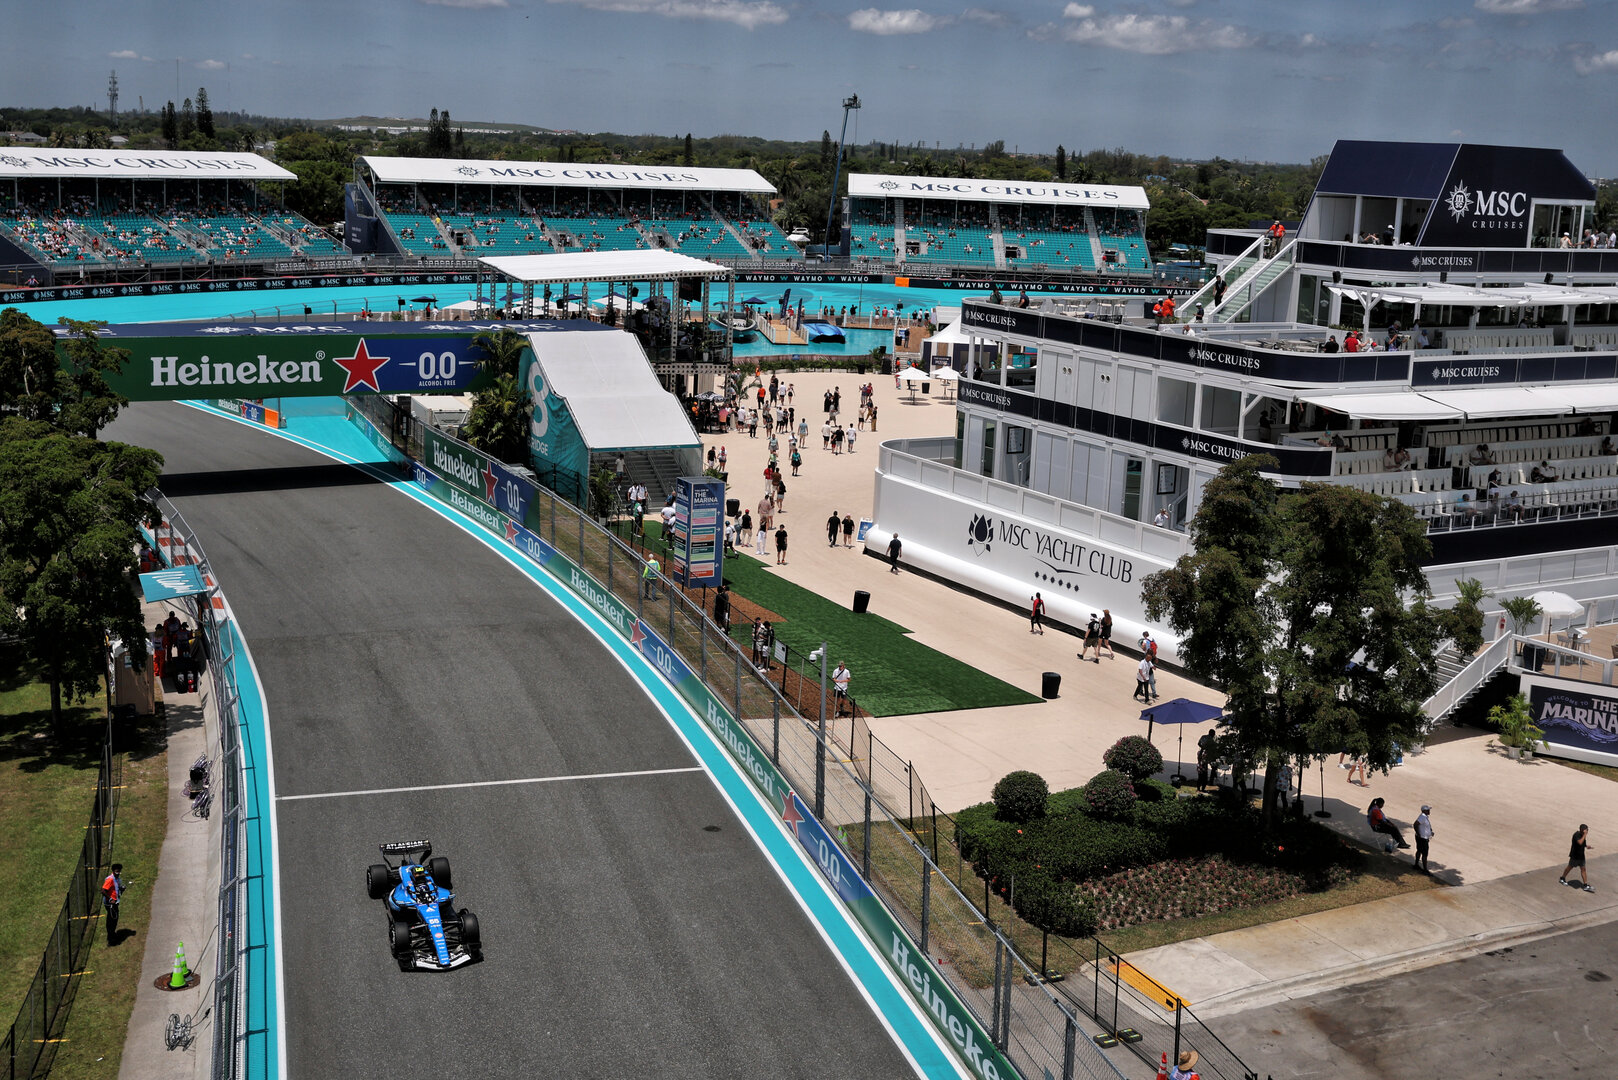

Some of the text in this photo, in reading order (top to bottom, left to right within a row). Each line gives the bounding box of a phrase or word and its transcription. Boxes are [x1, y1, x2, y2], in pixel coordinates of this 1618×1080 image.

[31, 156, 257, 170] MSC CRUISES
[487, 167, 699, 183] MSC CRUISES
[910, 182, 1119, 200] MSC CRUISES
[1474, 190, 1527, 217] MSC
[1472, 220, 1524, 229] CRUISES
[1421, 256, 1473, 266] MSC CRUISES
[958, 281, 990, 289] WAYMO
[1114, 286, 1146, 294] WAYMO
[969, 310, 1017, 327] MSC CRUISES
[418, 351, 456, 380] 0.0
[1196, 349, 1260, 370] MSC CRUISES
[150, 354, 323, 387] Heineken
[1441, 366, 1500, 378] MSC CRUISES
[528, 361, 549, 438] 8
[966, 388, 1011, 407] MSC CRUISES
[1190, 439, 1210, 453] MSC
[432, 440, 480, 489] Heineken
[450, 488, 500, 530] Heineken
[999, 520, 1133, 584] MSC YACHT CLUB
[570, 567, 625, 629] Heineken
[1592, 698, 1618, 713] THE
[1540, 701, 1618, 735] MARINA
[706, 698, 774, 797] Heineken
[818, 839, 841, 883] 0.0
[891, 931, 1005, 1080] Heineke
